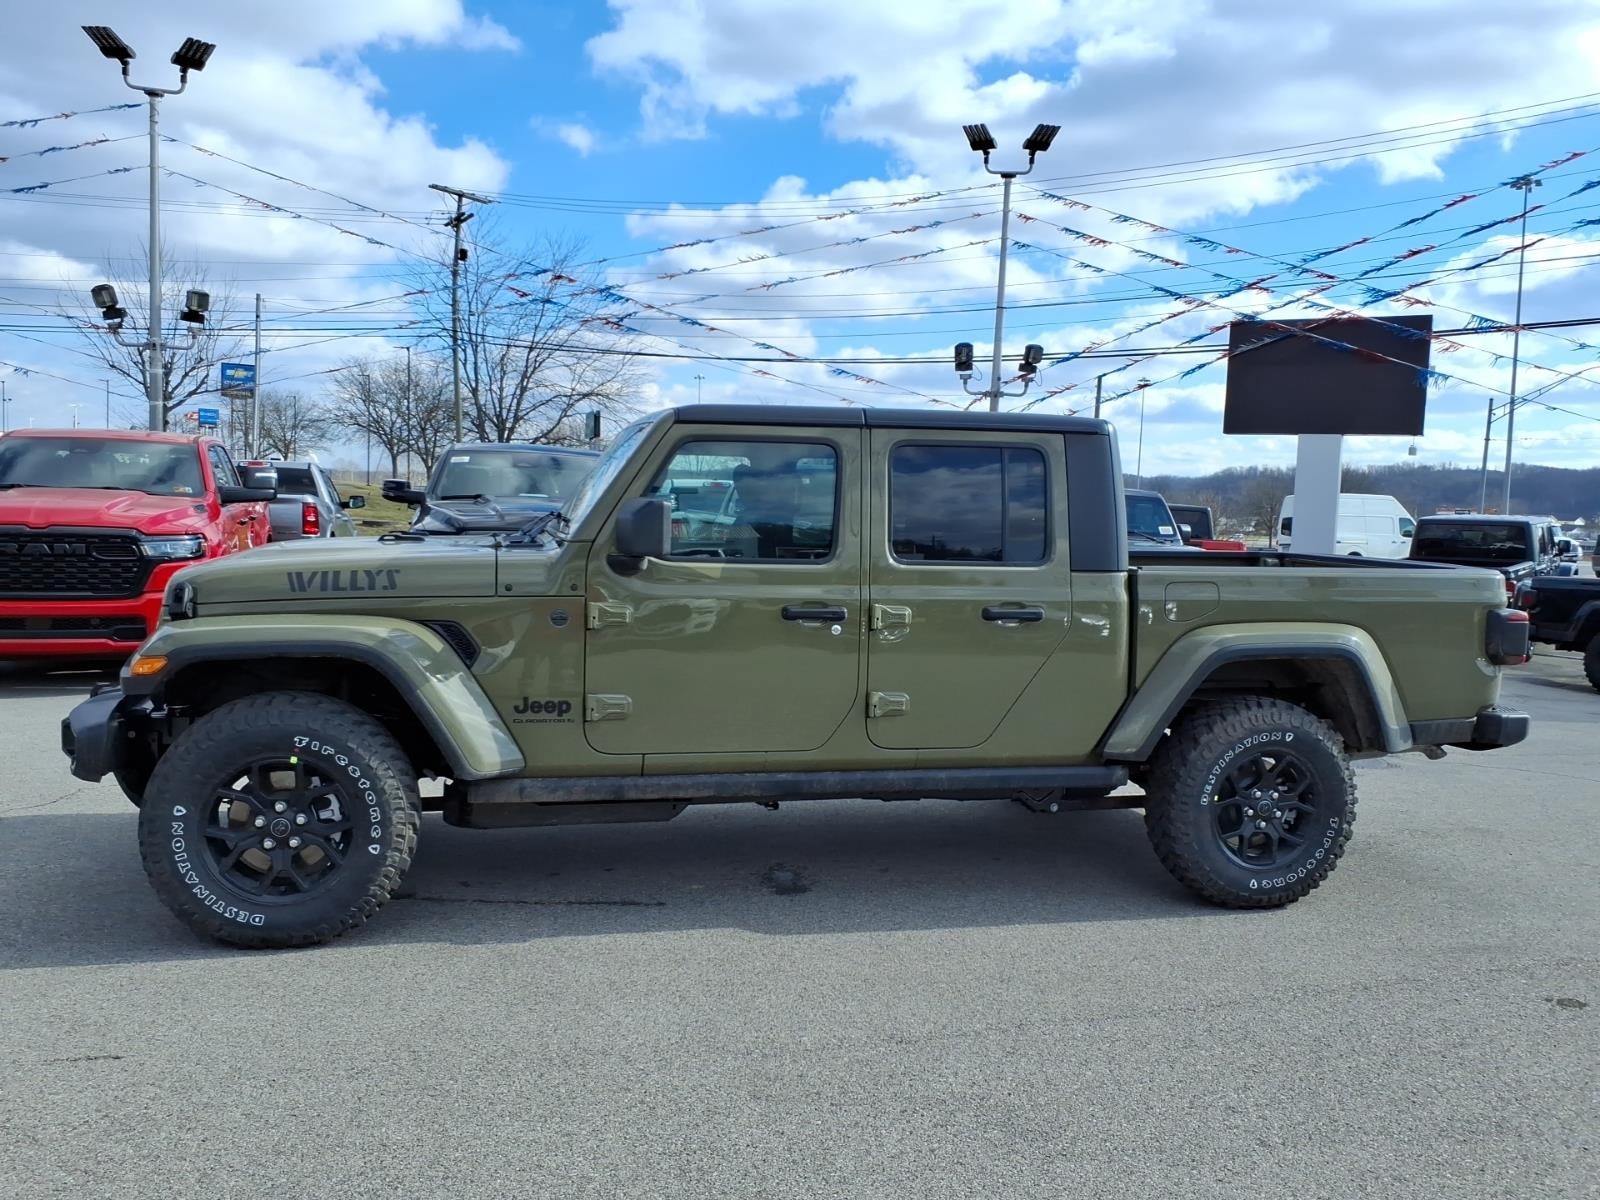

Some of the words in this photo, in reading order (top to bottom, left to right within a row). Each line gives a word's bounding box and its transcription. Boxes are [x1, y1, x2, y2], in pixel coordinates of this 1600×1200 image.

[287, 569, 400, 592] WILLYS
[513, 696, 571, 717] Jeep
[1200, 731, 1282, 806] DESTINATION
[171, 821, 265, 926] DESTINATION
